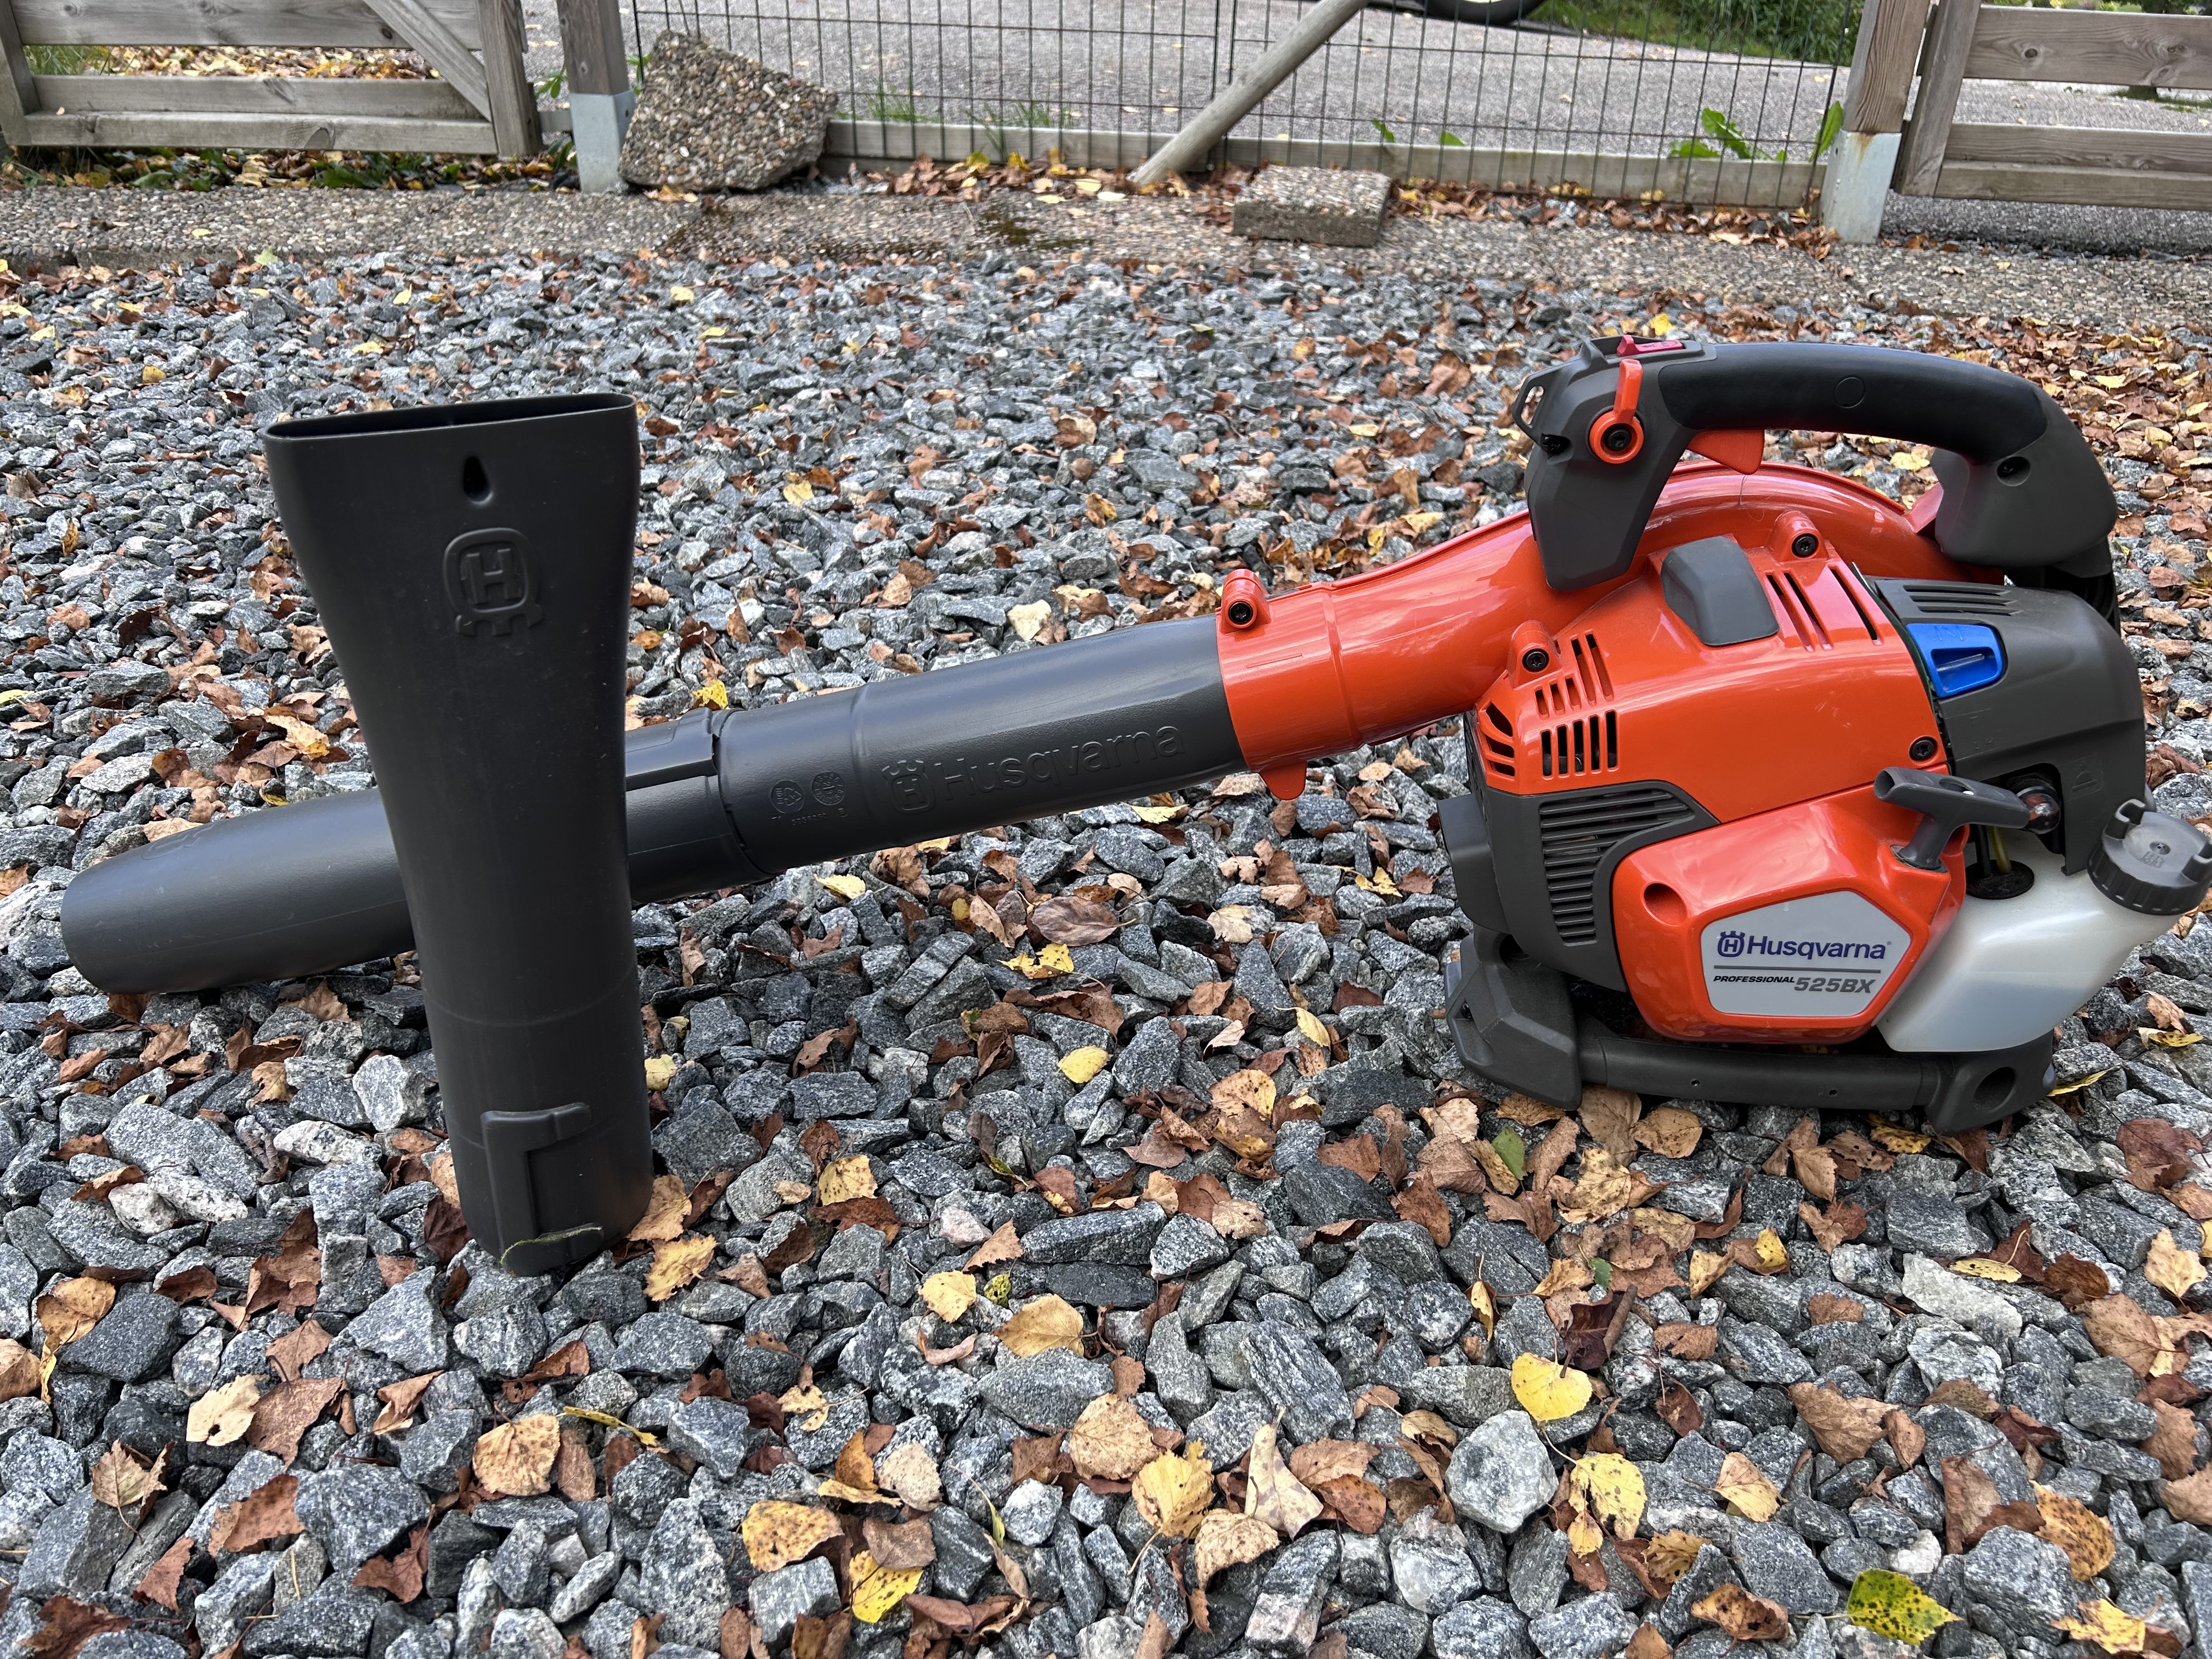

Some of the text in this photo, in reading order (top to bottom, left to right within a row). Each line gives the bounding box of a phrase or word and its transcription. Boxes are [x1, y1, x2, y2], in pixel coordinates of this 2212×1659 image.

[934, 725, 1186, 800] Husqvarna
[1747, 935, 1886, 960] Husqvarna
[1794, 977, 1876, 994] 525BX
